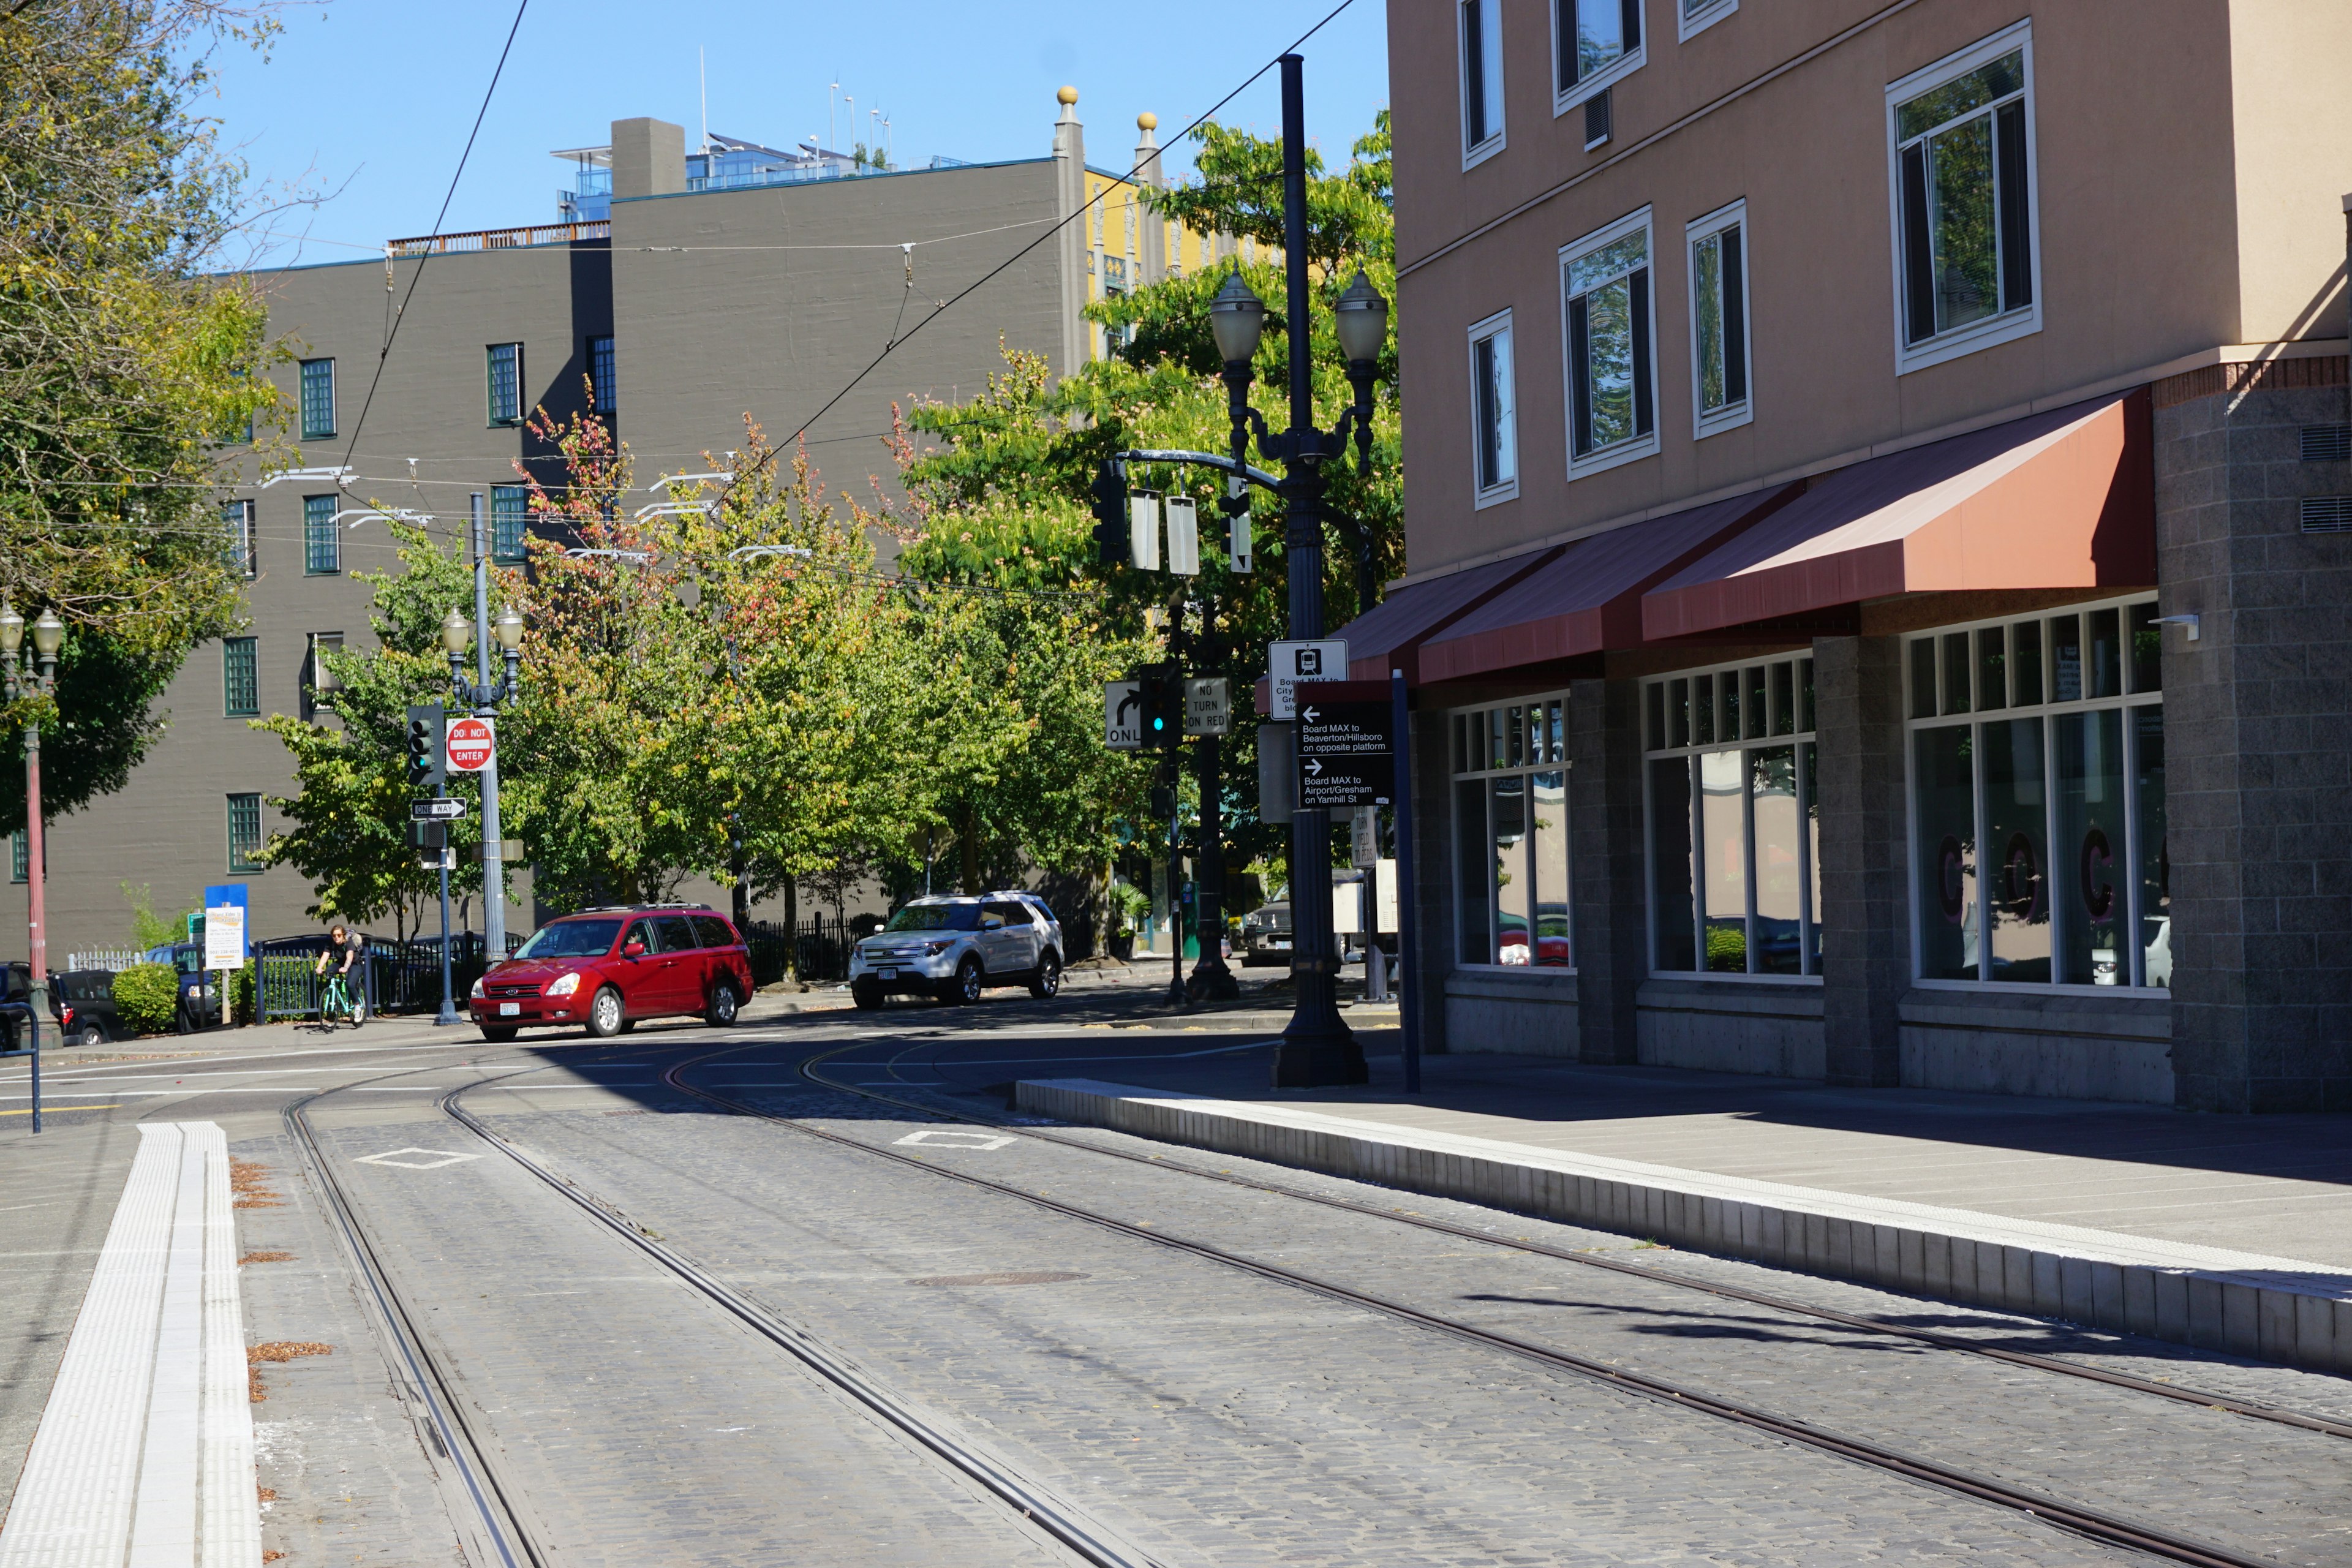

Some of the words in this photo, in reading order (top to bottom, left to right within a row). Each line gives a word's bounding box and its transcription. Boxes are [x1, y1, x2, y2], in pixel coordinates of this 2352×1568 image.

[1200, 686, 1212, 695] NO
[1194, 701, 1217, 711] TURN
[1189, 717, 1200, 727] ON
[1207, 715, 1224, 726] RED
[454, 729, 464, 738] DO
[470, 728, 486, 737] NOT
[1110, 729, 1141, 742] ONL
[1303, 733, 1382, 742] Beaverton/Hillsboro
[1316, 743, 1351, 753] opposite
[1353, 742, 1385, 752] platform
[457, 752, 483, 761] ENTER
[1305, 777, 1329, 785] Board
[1305, 785, 1372, 796] Airport/Gresham
[1317, 795, 1346, 804] Yamhill
[1357, 816, 1367, 830] TURN
[1357, 833, 1369, 845] YIELD
[1355, 850, 1360, 862] TO
[1361, 848, 1373, 862] PEDS
